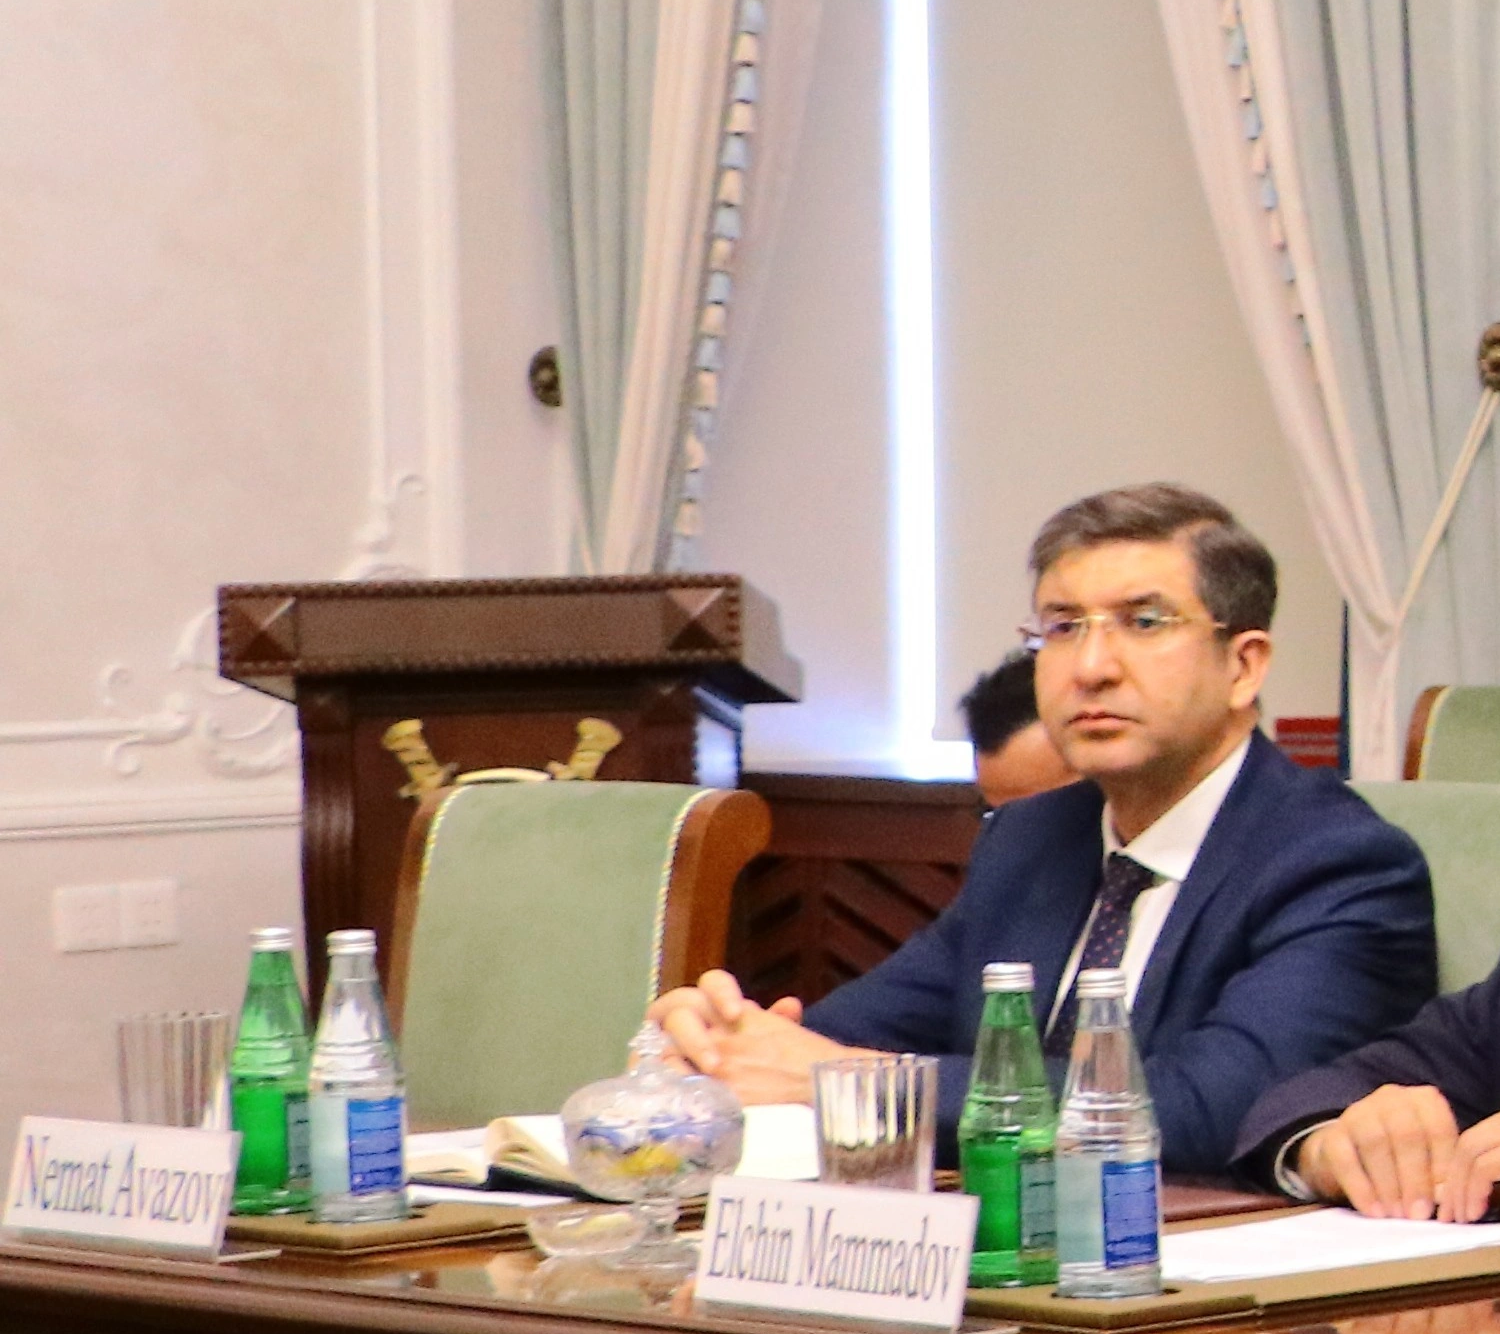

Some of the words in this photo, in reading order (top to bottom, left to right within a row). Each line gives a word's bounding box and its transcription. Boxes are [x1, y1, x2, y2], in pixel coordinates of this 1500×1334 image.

[14, 1133, 112, 1215] Nemat
[109, 1141, 224, 1225] Avazov
[707, 1197, 794, 1285] Elchin
[795, 1206, 960, 1301] Mammadov
